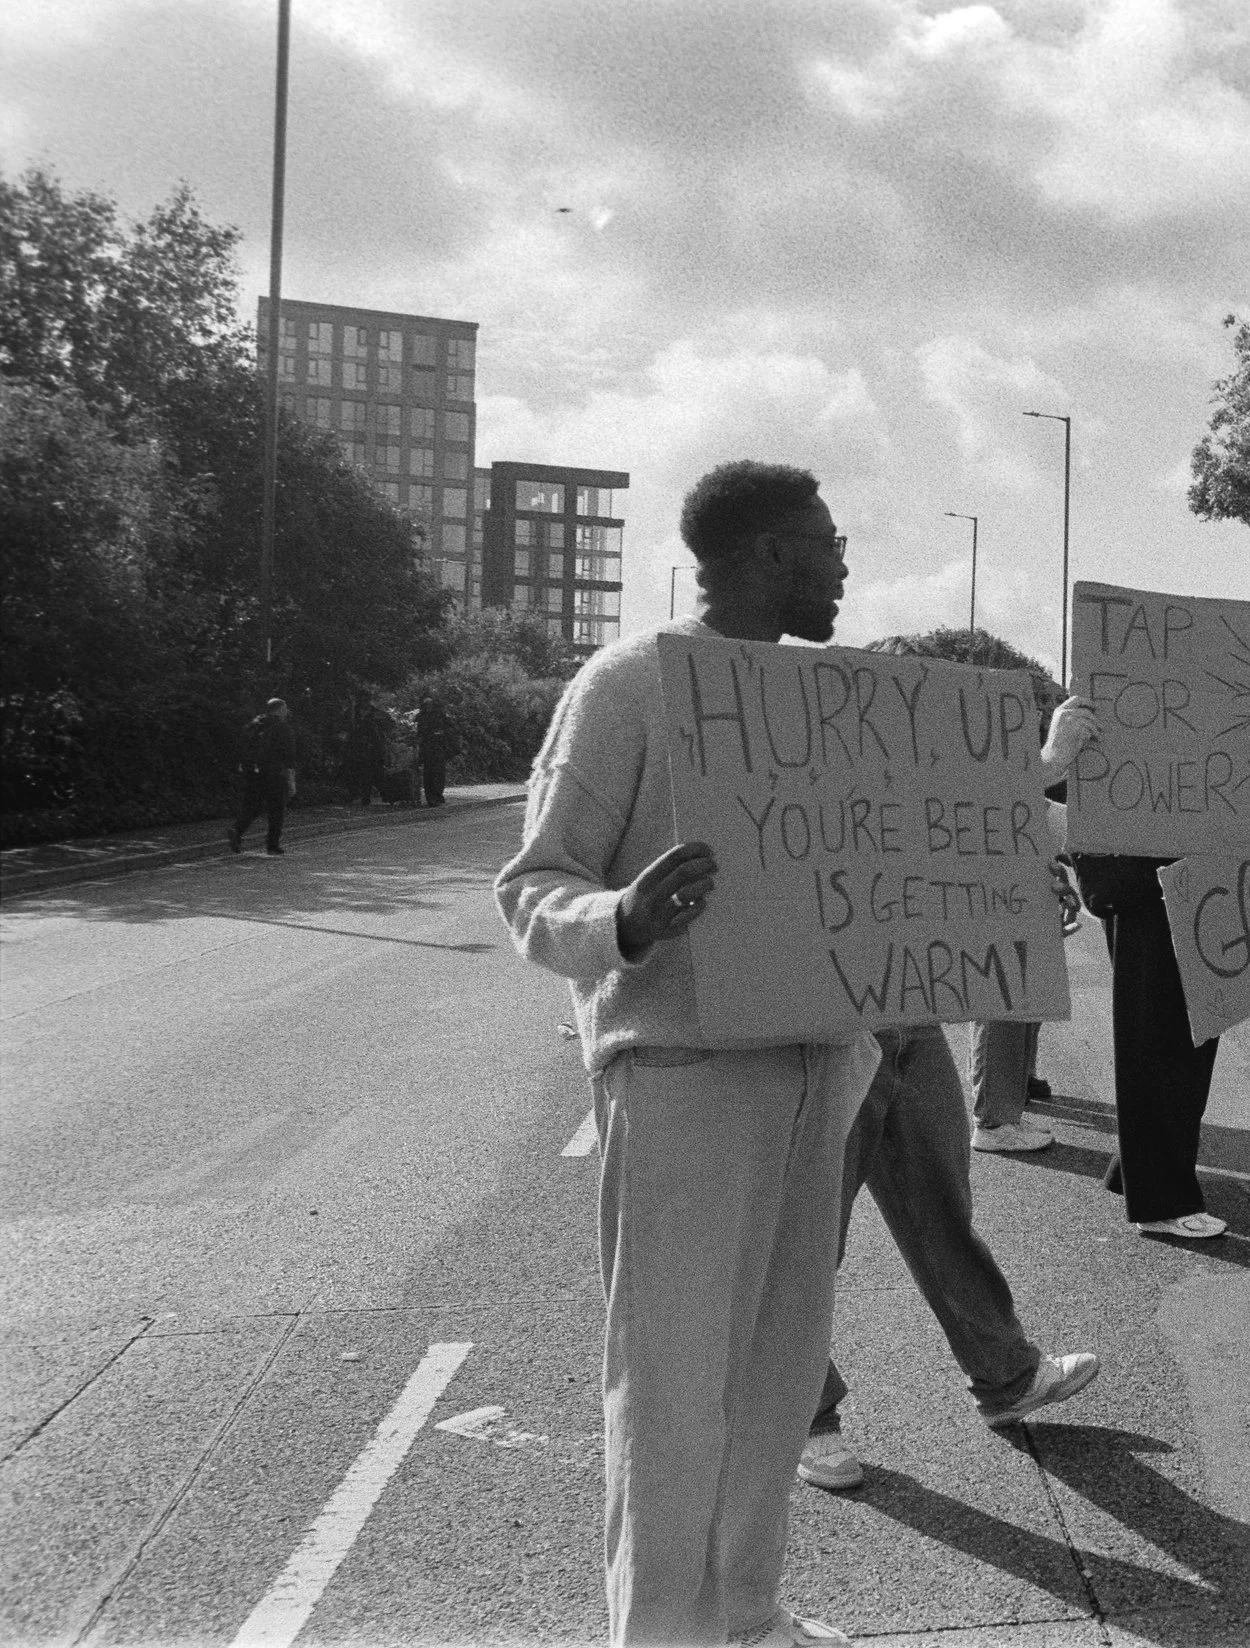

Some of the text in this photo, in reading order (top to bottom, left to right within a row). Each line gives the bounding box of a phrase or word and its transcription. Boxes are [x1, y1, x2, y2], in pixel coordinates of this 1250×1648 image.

[1077, 594, 1195, 660] TAP
[687, 652, 924, 776] HURRY
[1089, 671, 1198, 733] FOR
[1074, 750, 1237, 815] POWER
[924, 796, 1040, 857] BEER
[813, 869, 1029, 933] IS GETTING
[828, 939, 1028, 1016] WARM!
